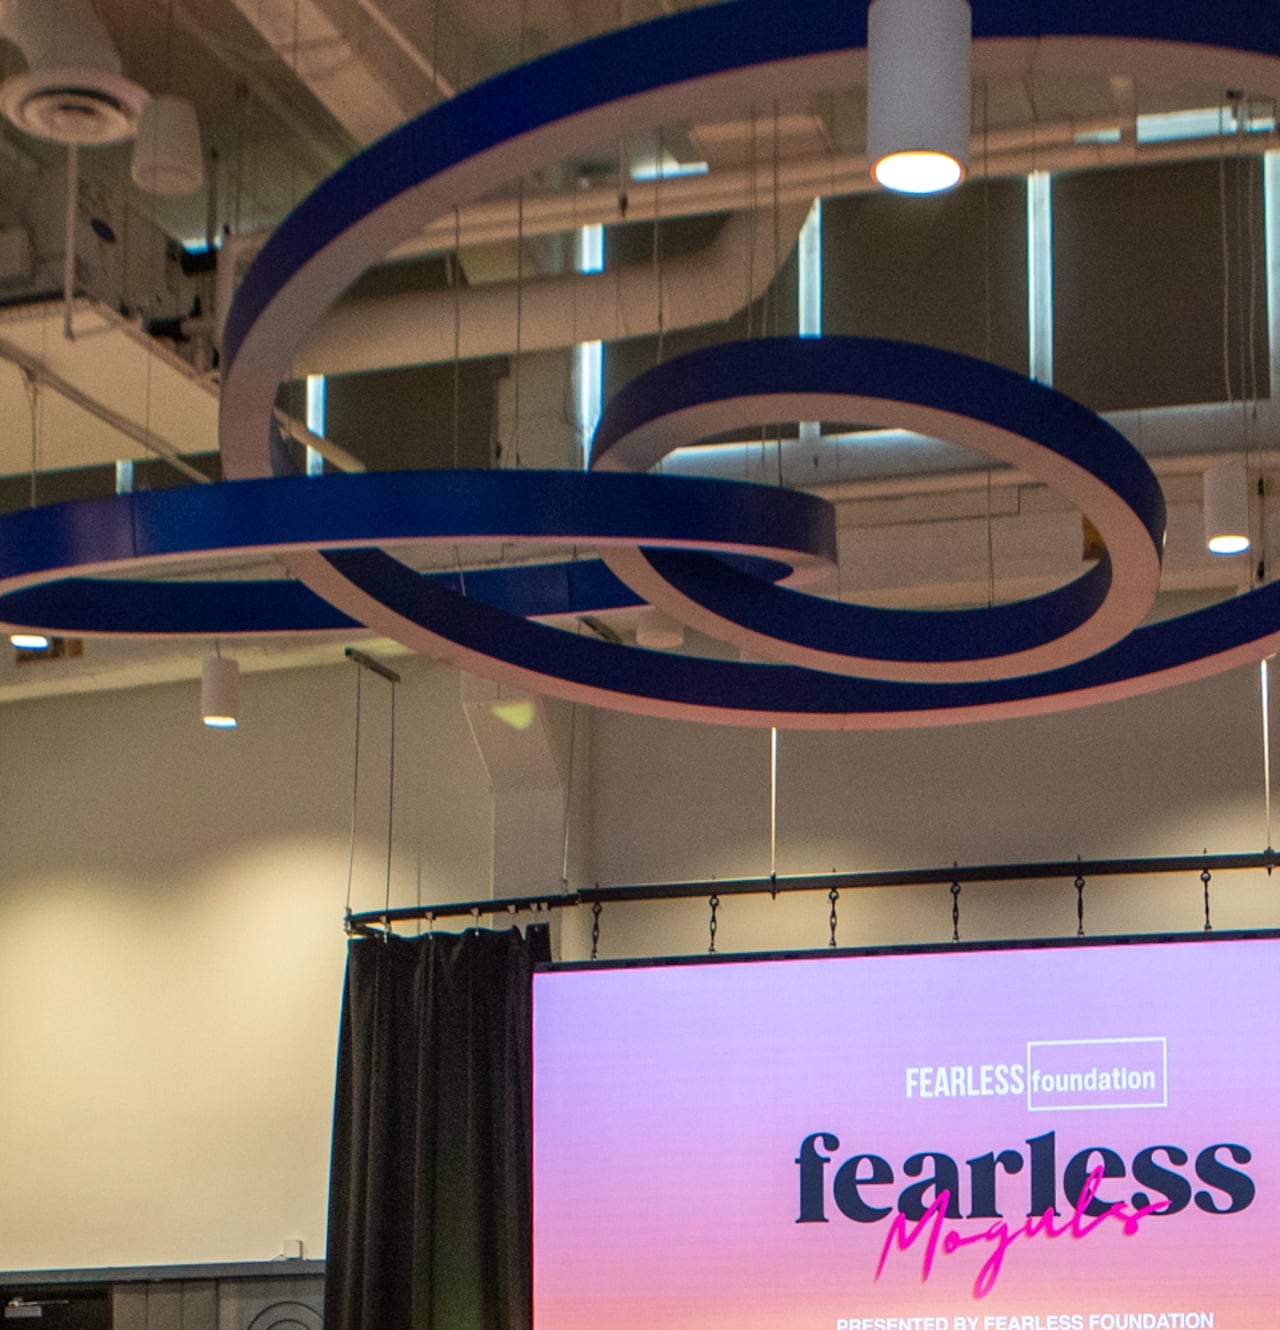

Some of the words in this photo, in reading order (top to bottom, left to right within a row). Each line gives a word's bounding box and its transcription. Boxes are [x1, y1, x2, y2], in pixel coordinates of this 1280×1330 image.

[905, 1063, 1025, 1098] FEARLESS
[1031, 1066, 1156, 1093] foundation
[794, 1130, 1256, 1225] fearless
[873, 1164, 1172, 1300] Moguls
[1088, 1312, 1215, 1330] FOUNDATION
